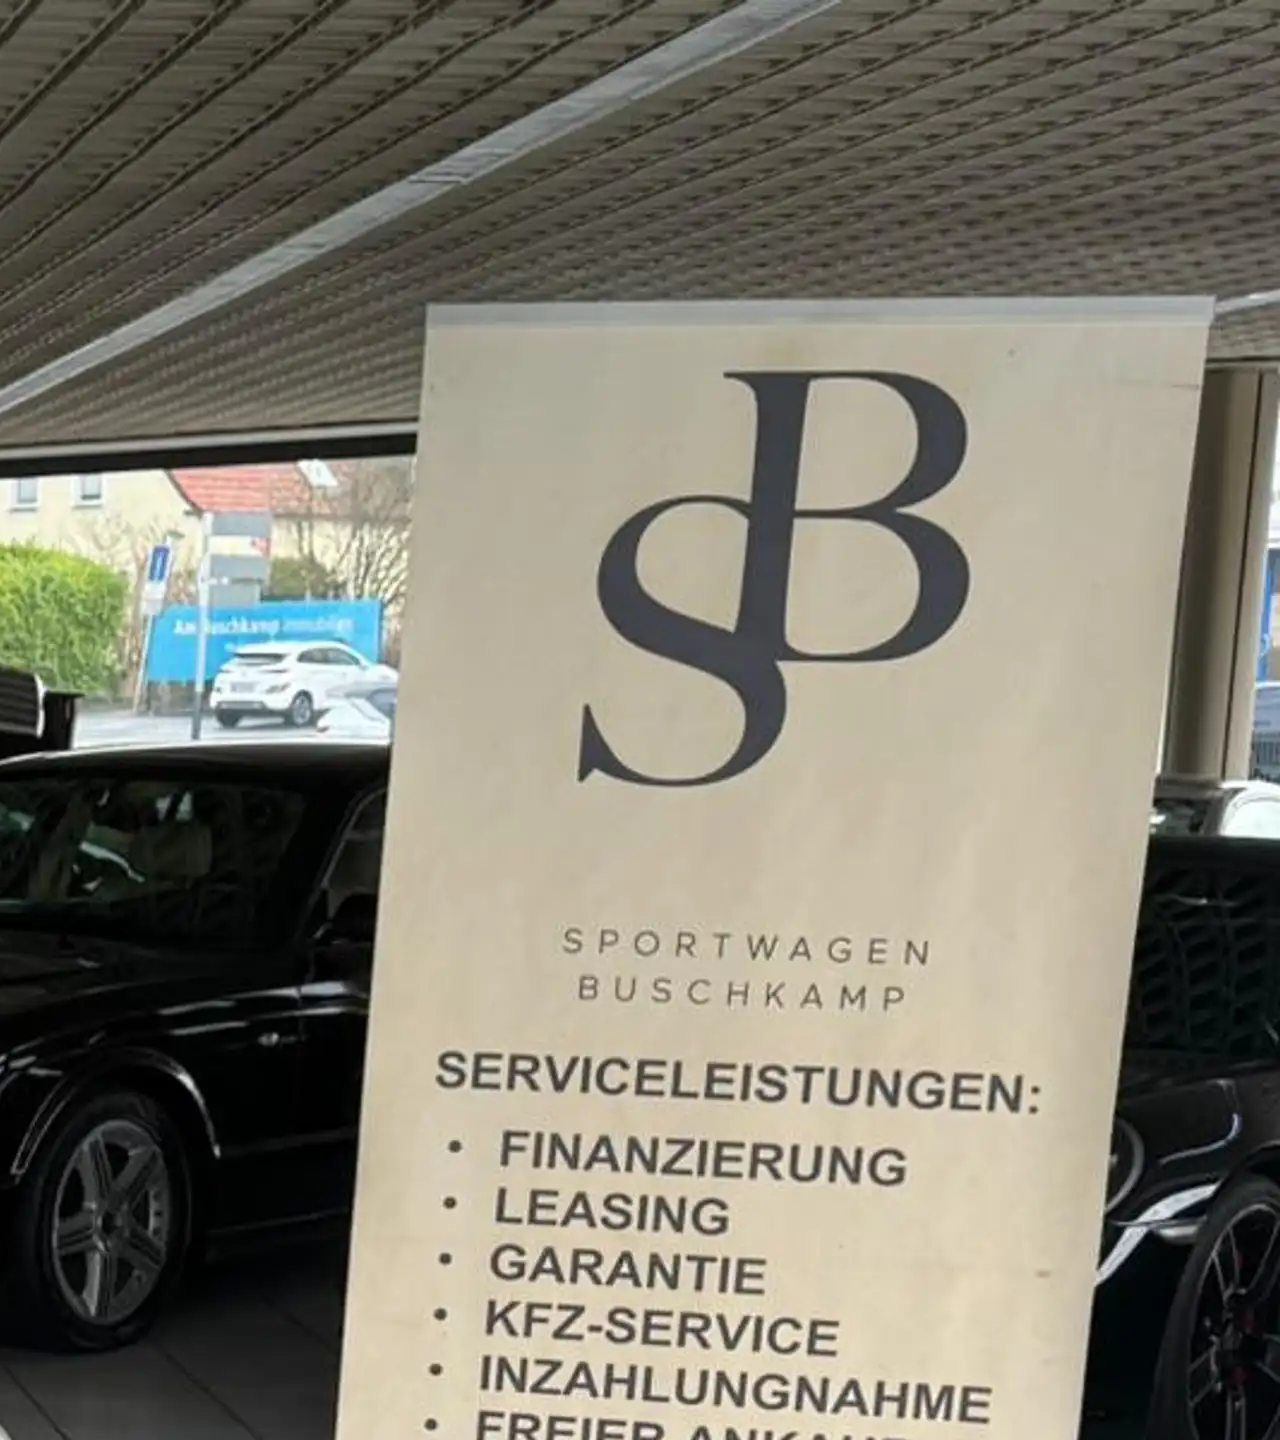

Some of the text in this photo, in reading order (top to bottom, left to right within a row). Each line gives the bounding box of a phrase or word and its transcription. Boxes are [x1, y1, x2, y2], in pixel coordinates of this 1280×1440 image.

[562, 926, 930, 967] SPORTWAGEN
[577, 973, 906, 1013] BUSCHKAMP
[434, 1050, 1041, 1115] SERVICELEISTUNGEN:
[499, 1128, 908, 1188] FINANZIERUNG
[493, 1185, 731, 1238] LEASING
[488, 1242, 768, 1297] GARANTIE
[483, 1298, 841, 1358] KFZ-SERVICE
[477, 1354, 994, 1426] INZAHLUNGNAHME
